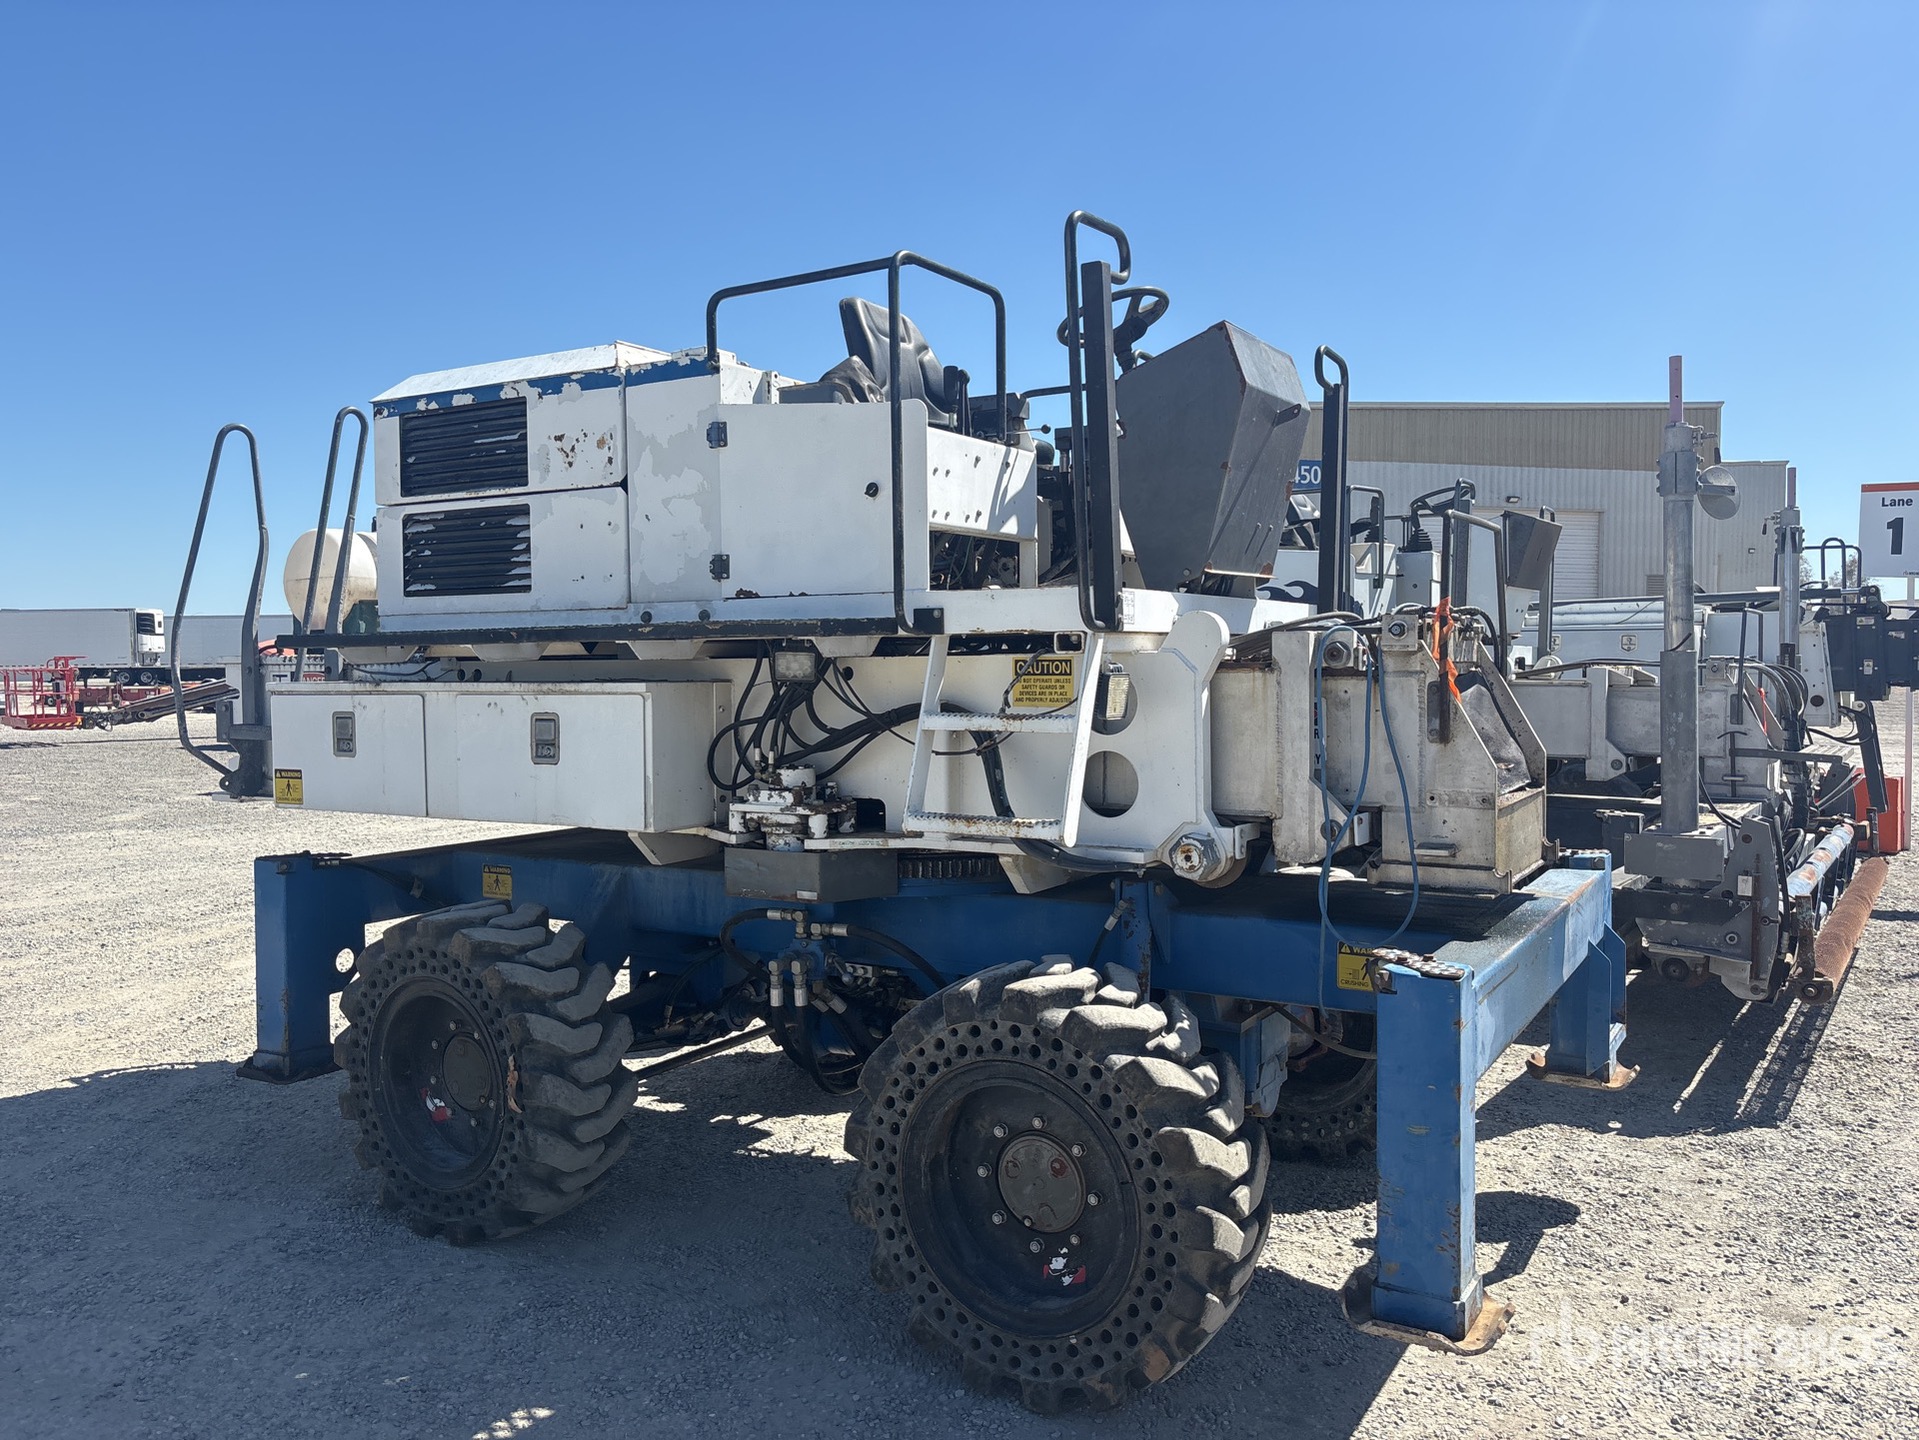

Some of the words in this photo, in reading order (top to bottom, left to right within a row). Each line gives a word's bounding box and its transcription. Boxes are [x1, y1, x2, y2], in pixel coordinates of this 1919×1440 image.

[1881, 497, 1914, 507] Lane
[1886, 517, 1904, 555] 1
[490, 866, 511, 874] WARNING
[1340, 978, 1369, 987] CRUSHING
